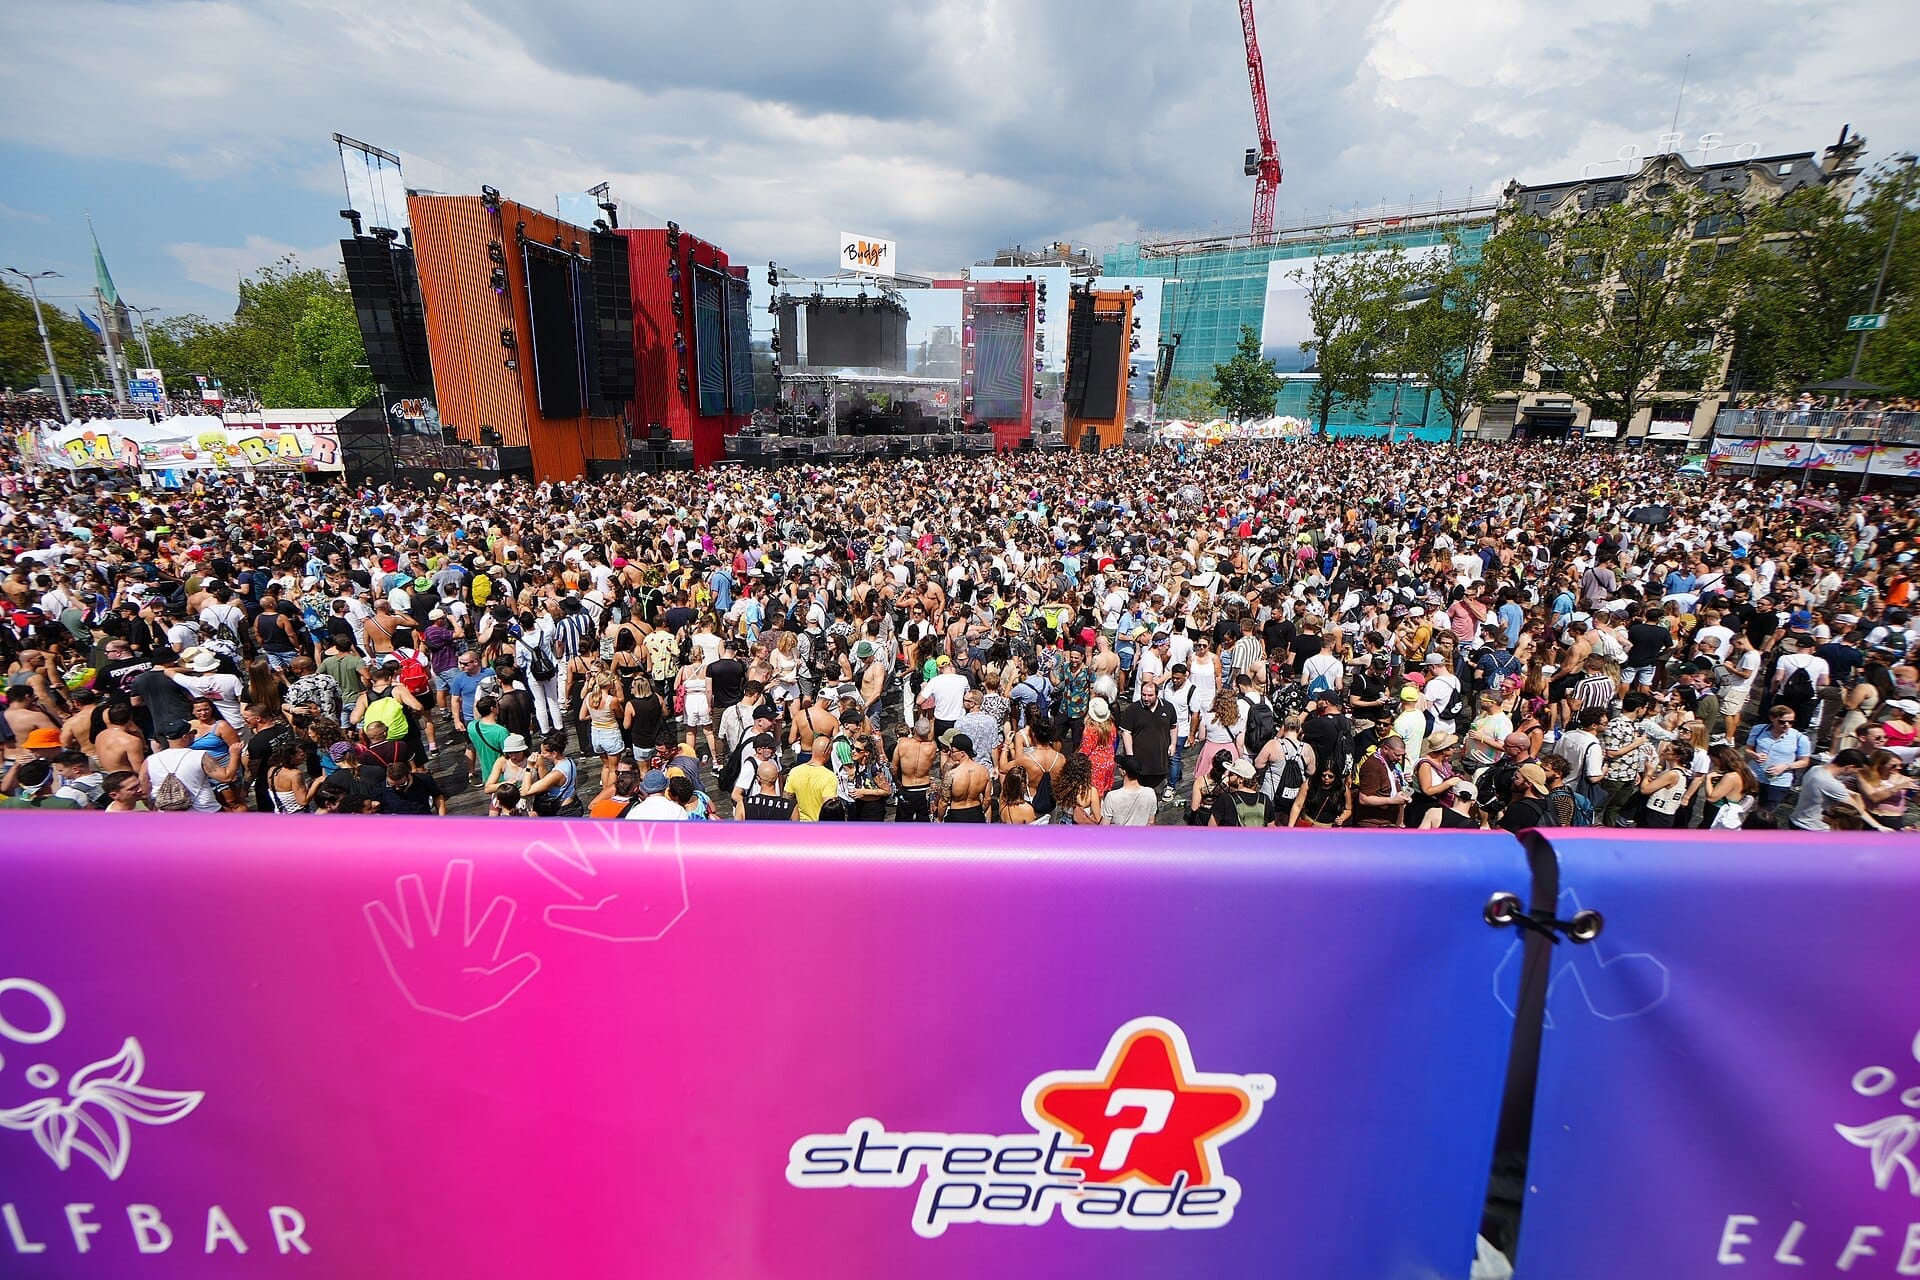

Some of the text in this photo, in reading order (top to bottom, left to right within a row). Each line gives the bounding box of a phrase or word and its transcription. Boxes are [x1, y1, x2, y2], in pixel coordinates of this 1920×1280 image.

[1582, 131, 1761, 178] CORSO
[843, 242, 887, 267] Budget
[63, 433, 141, 469] BAR
[238, 432, 338, 466] BAR
[1716, 444, 1753, 458] DRINKS
[1824, 450, 1856, 466] BAR
[747, 796, 789, 809] ADIDAS
[801, 1130, 1091, 1177] street
[926, 1172, 1226, 1225] parade
